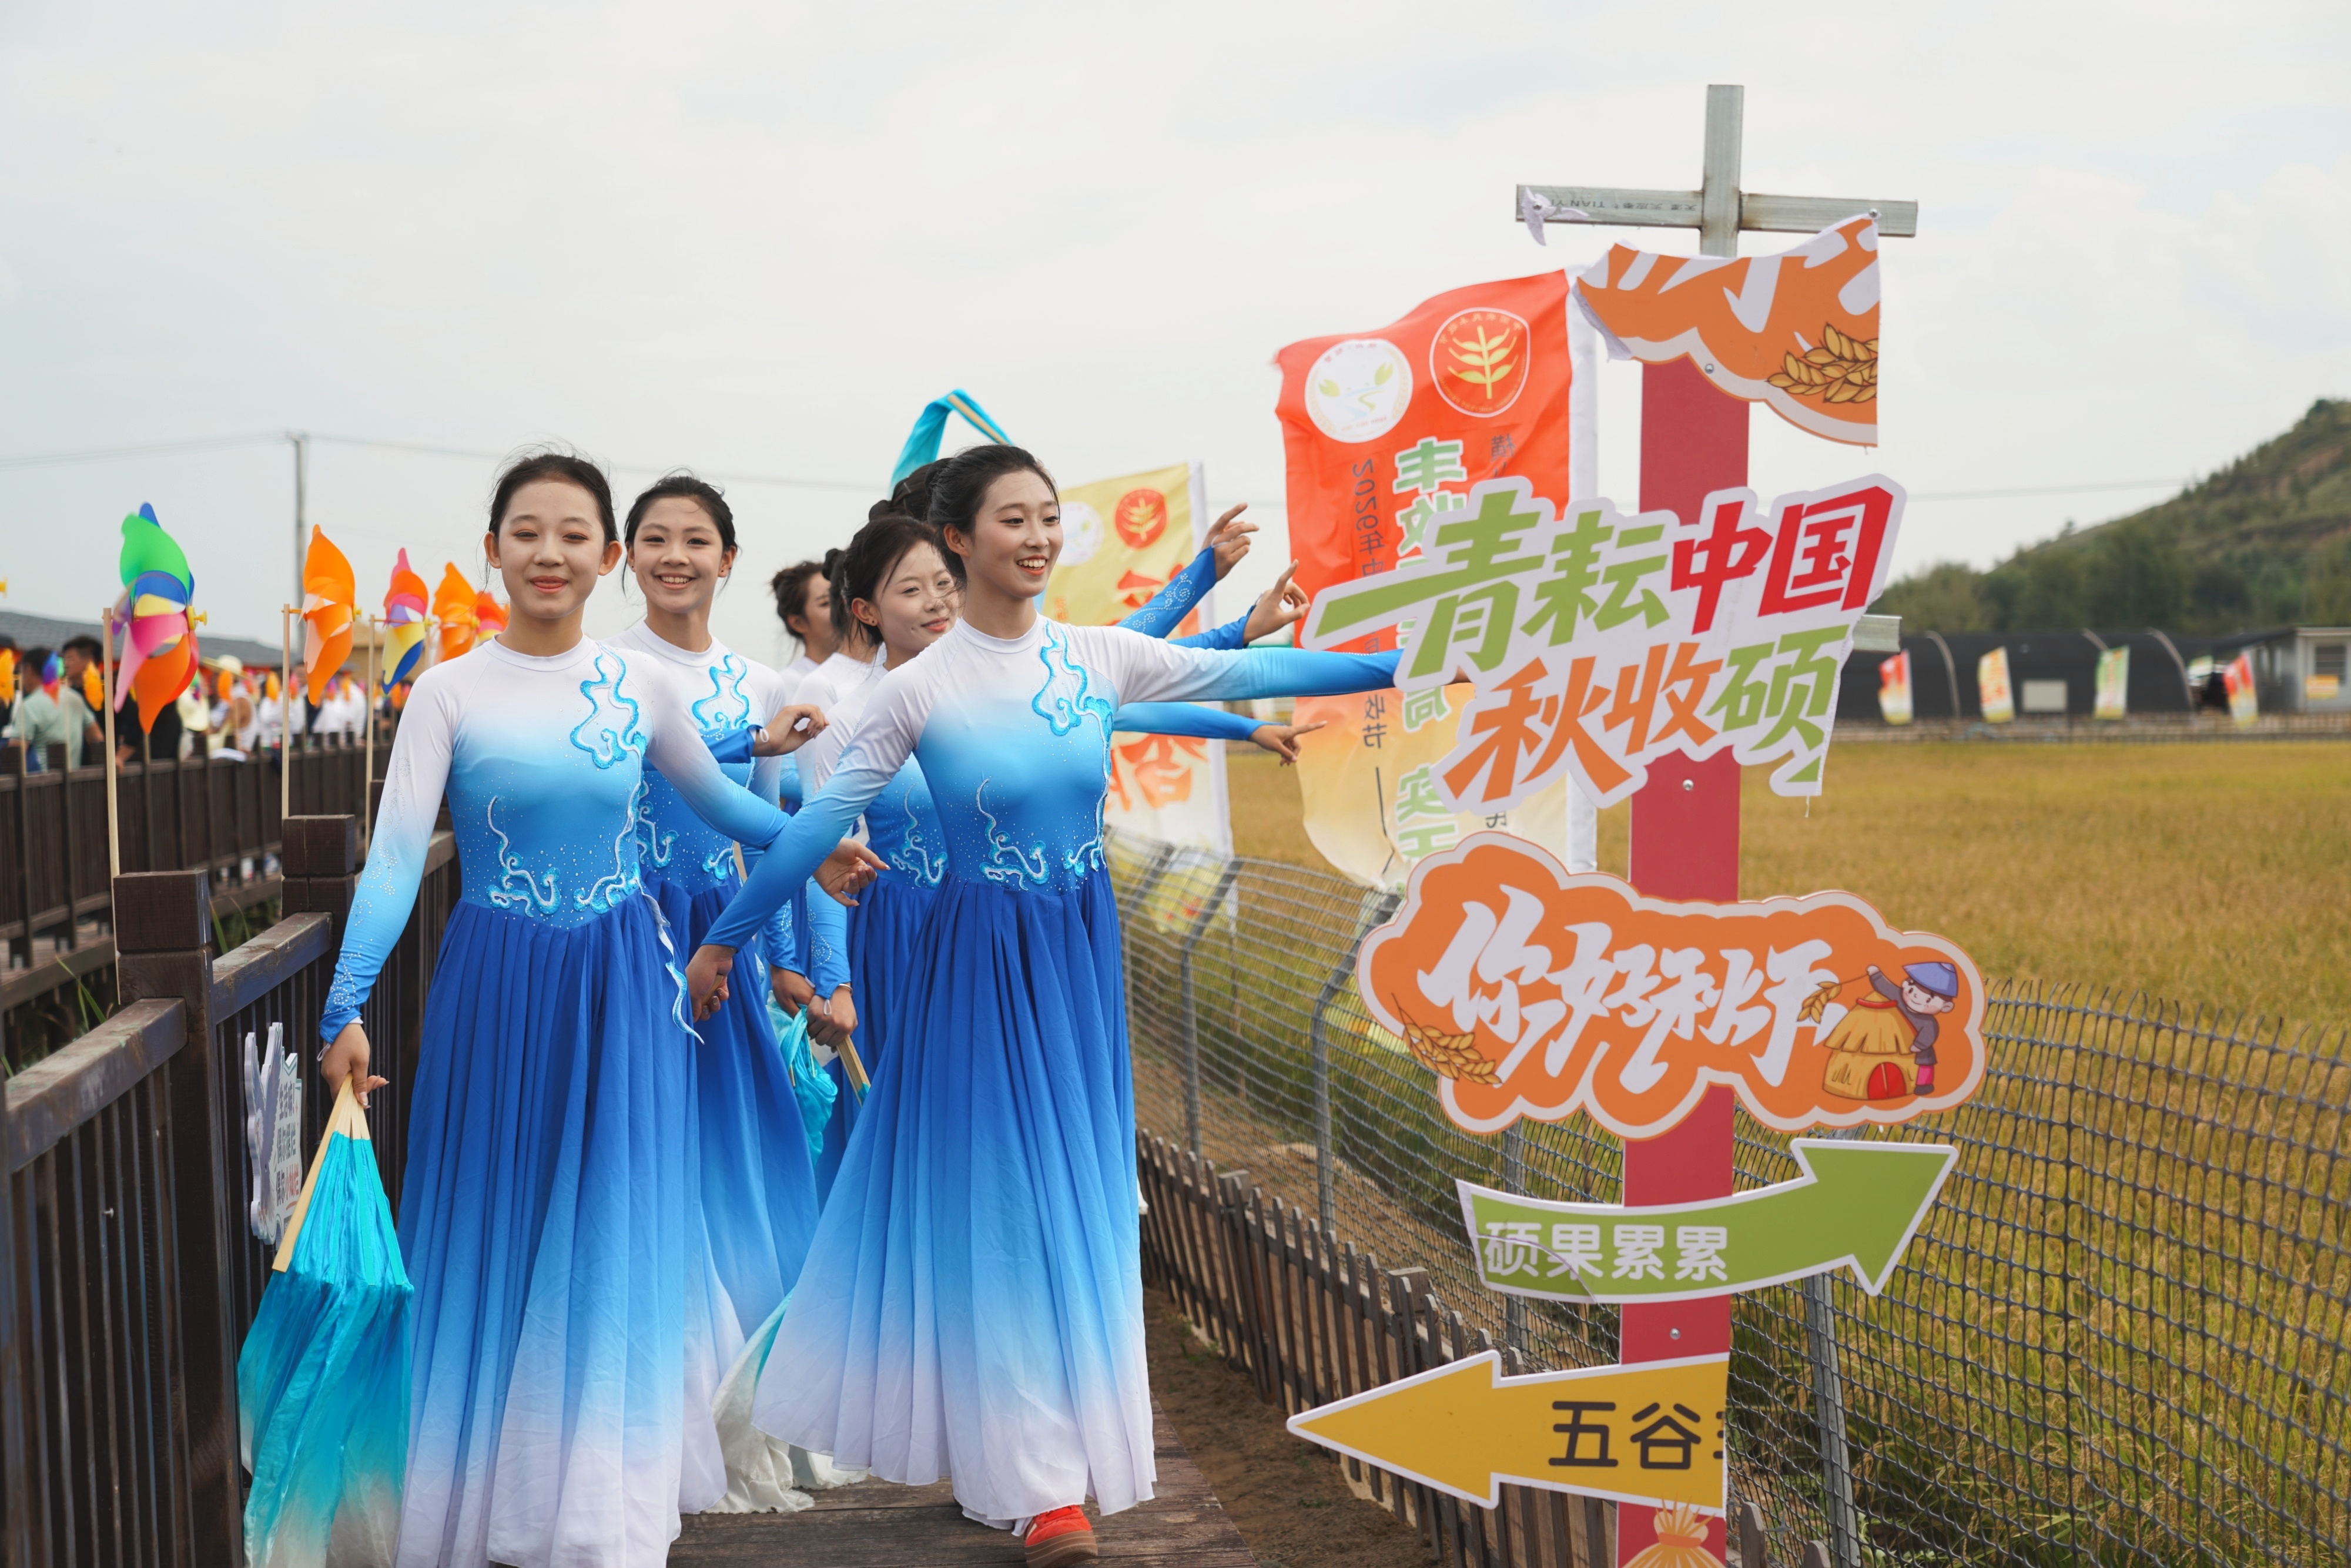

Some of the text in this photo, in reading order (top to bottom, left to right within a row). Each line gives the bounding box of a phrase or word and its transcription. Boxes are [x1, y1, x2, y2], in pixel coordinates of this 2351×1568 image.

[1570, 200, 1605, 208] TIAN
[1313, 486, 1894, 679] 青耘中国
[1443, 624, 1850, 802] 秋收硕
[1485, 1222, 1728, 1282] 硕果累累
[1548, 1401, 1724, 1470] 五谷
